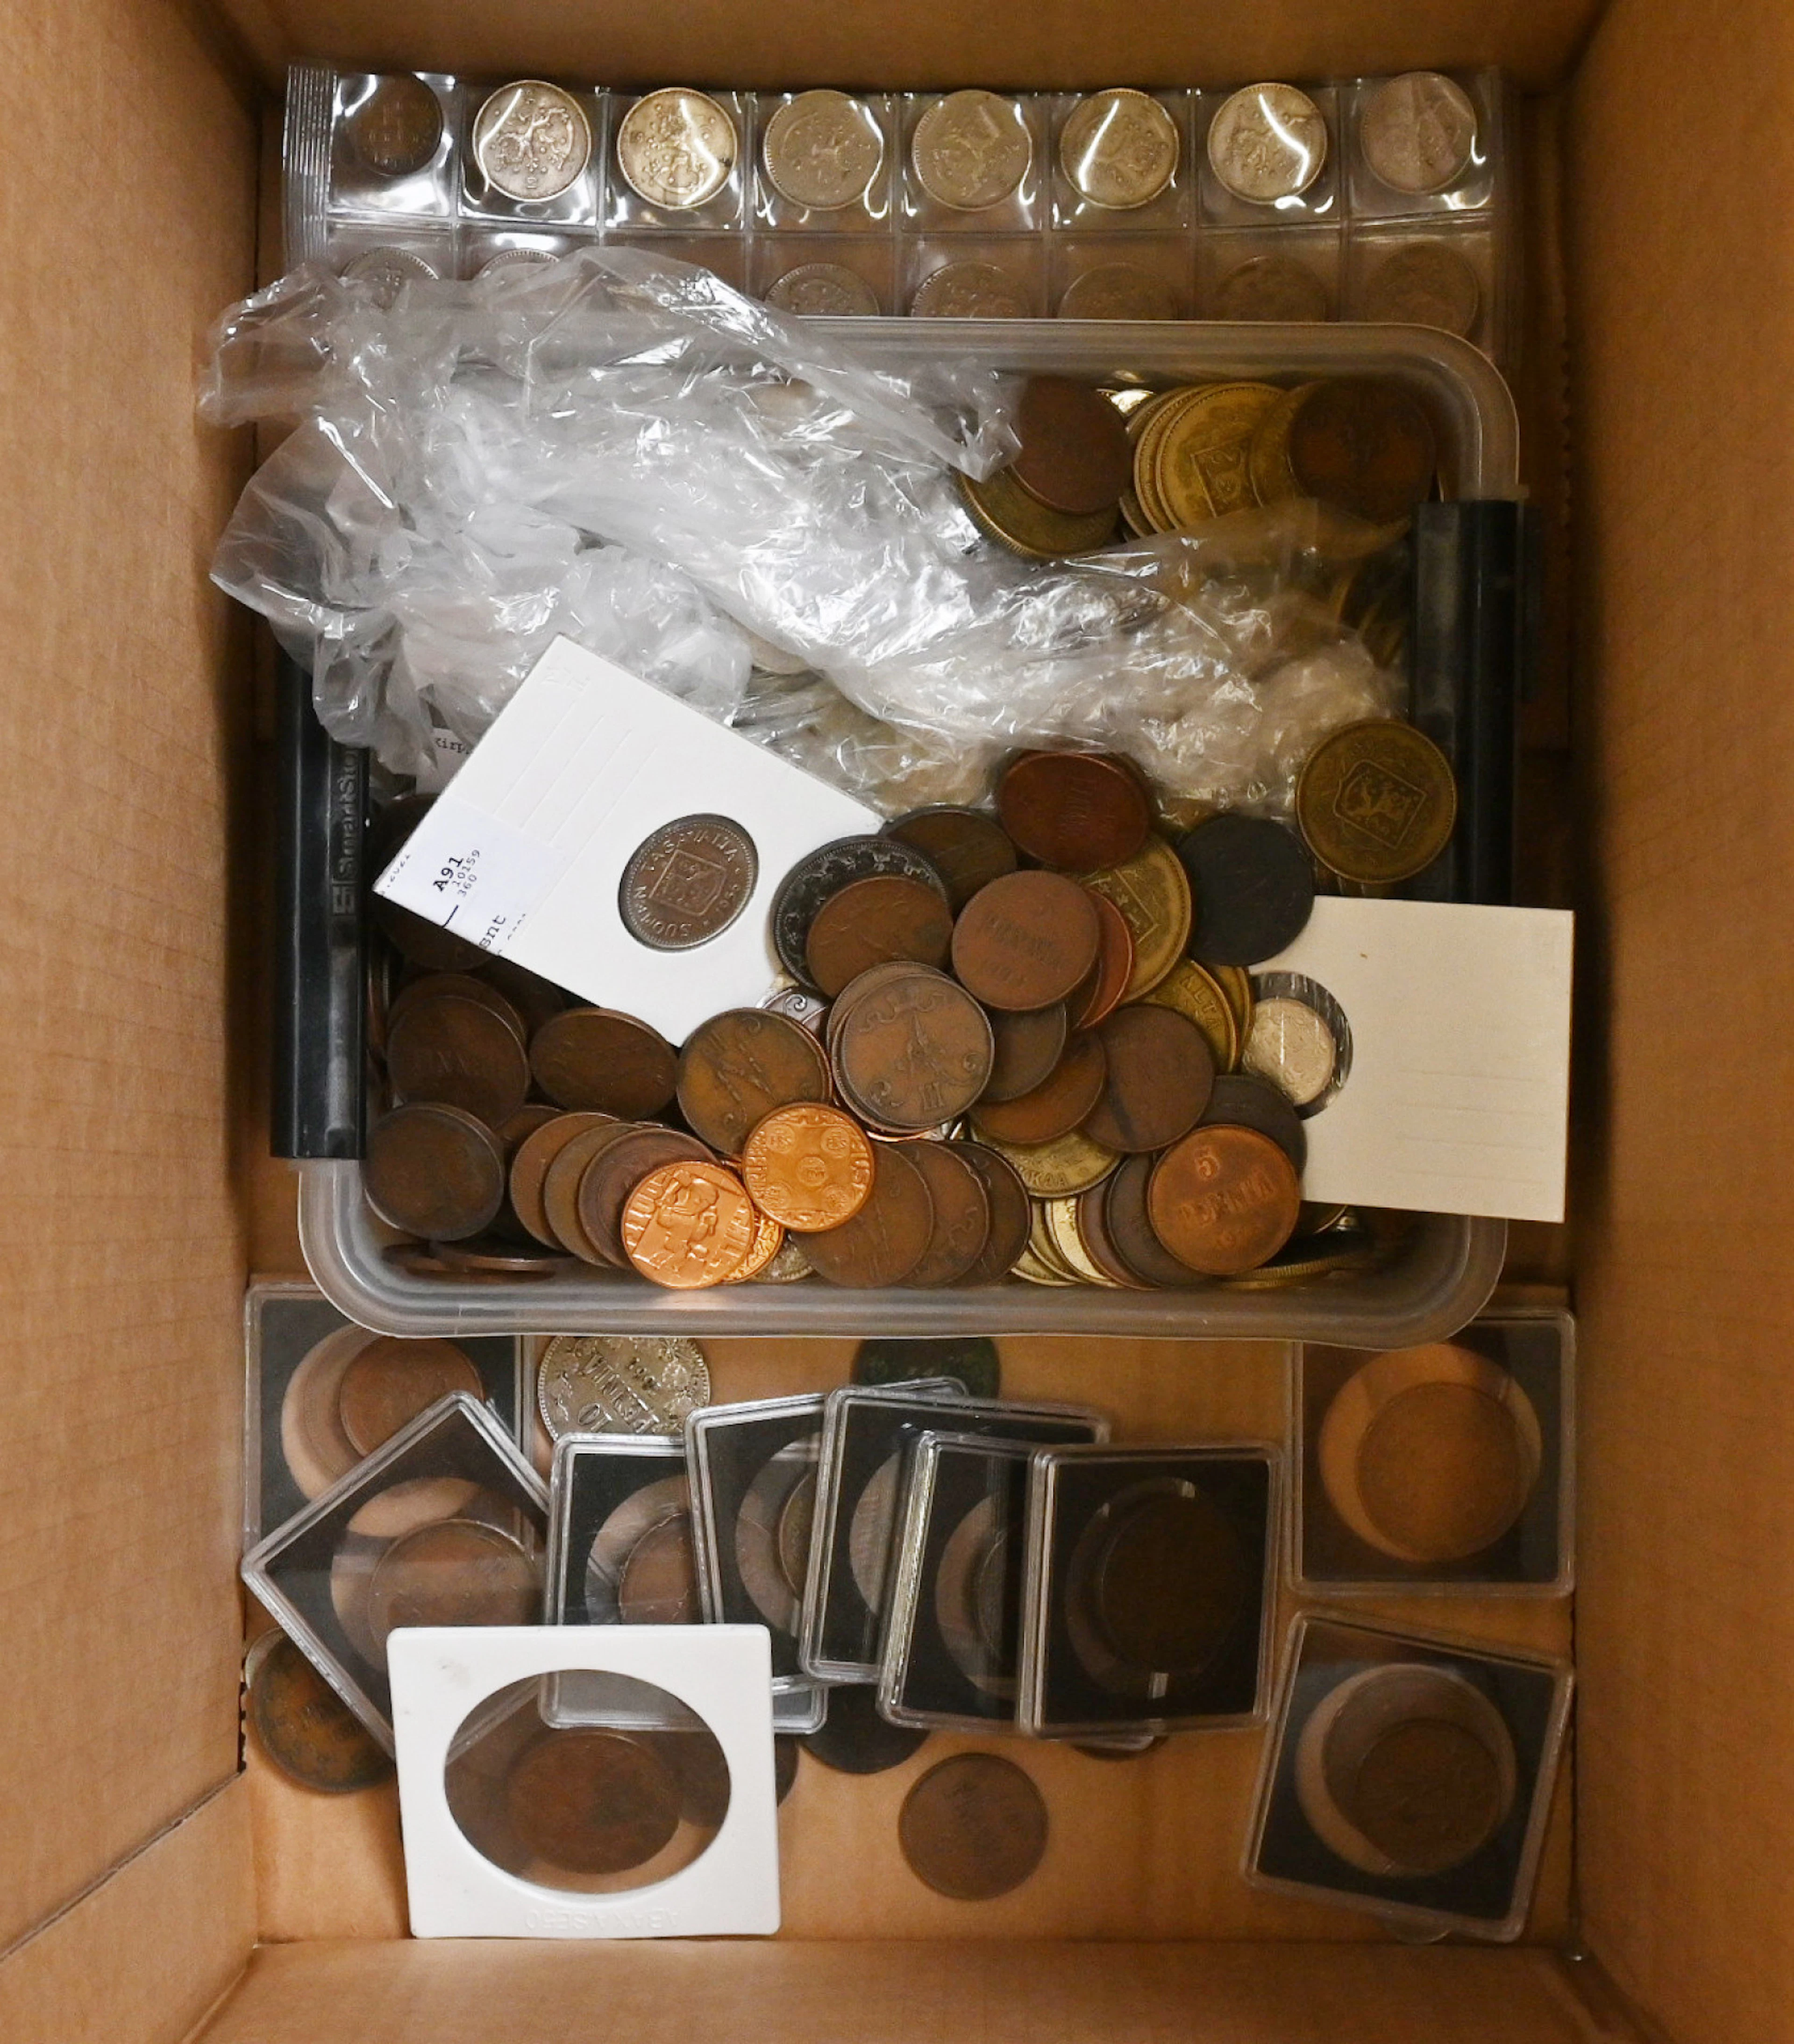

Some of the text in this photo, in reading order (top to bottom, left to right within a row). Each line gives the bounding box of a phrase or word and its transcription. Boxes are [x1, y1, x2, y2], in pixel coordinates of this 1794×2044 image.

[433, 856, 464, 892] A91
[452, 849, 480, 887] 10159
[457, 873, 477, 897] 360
